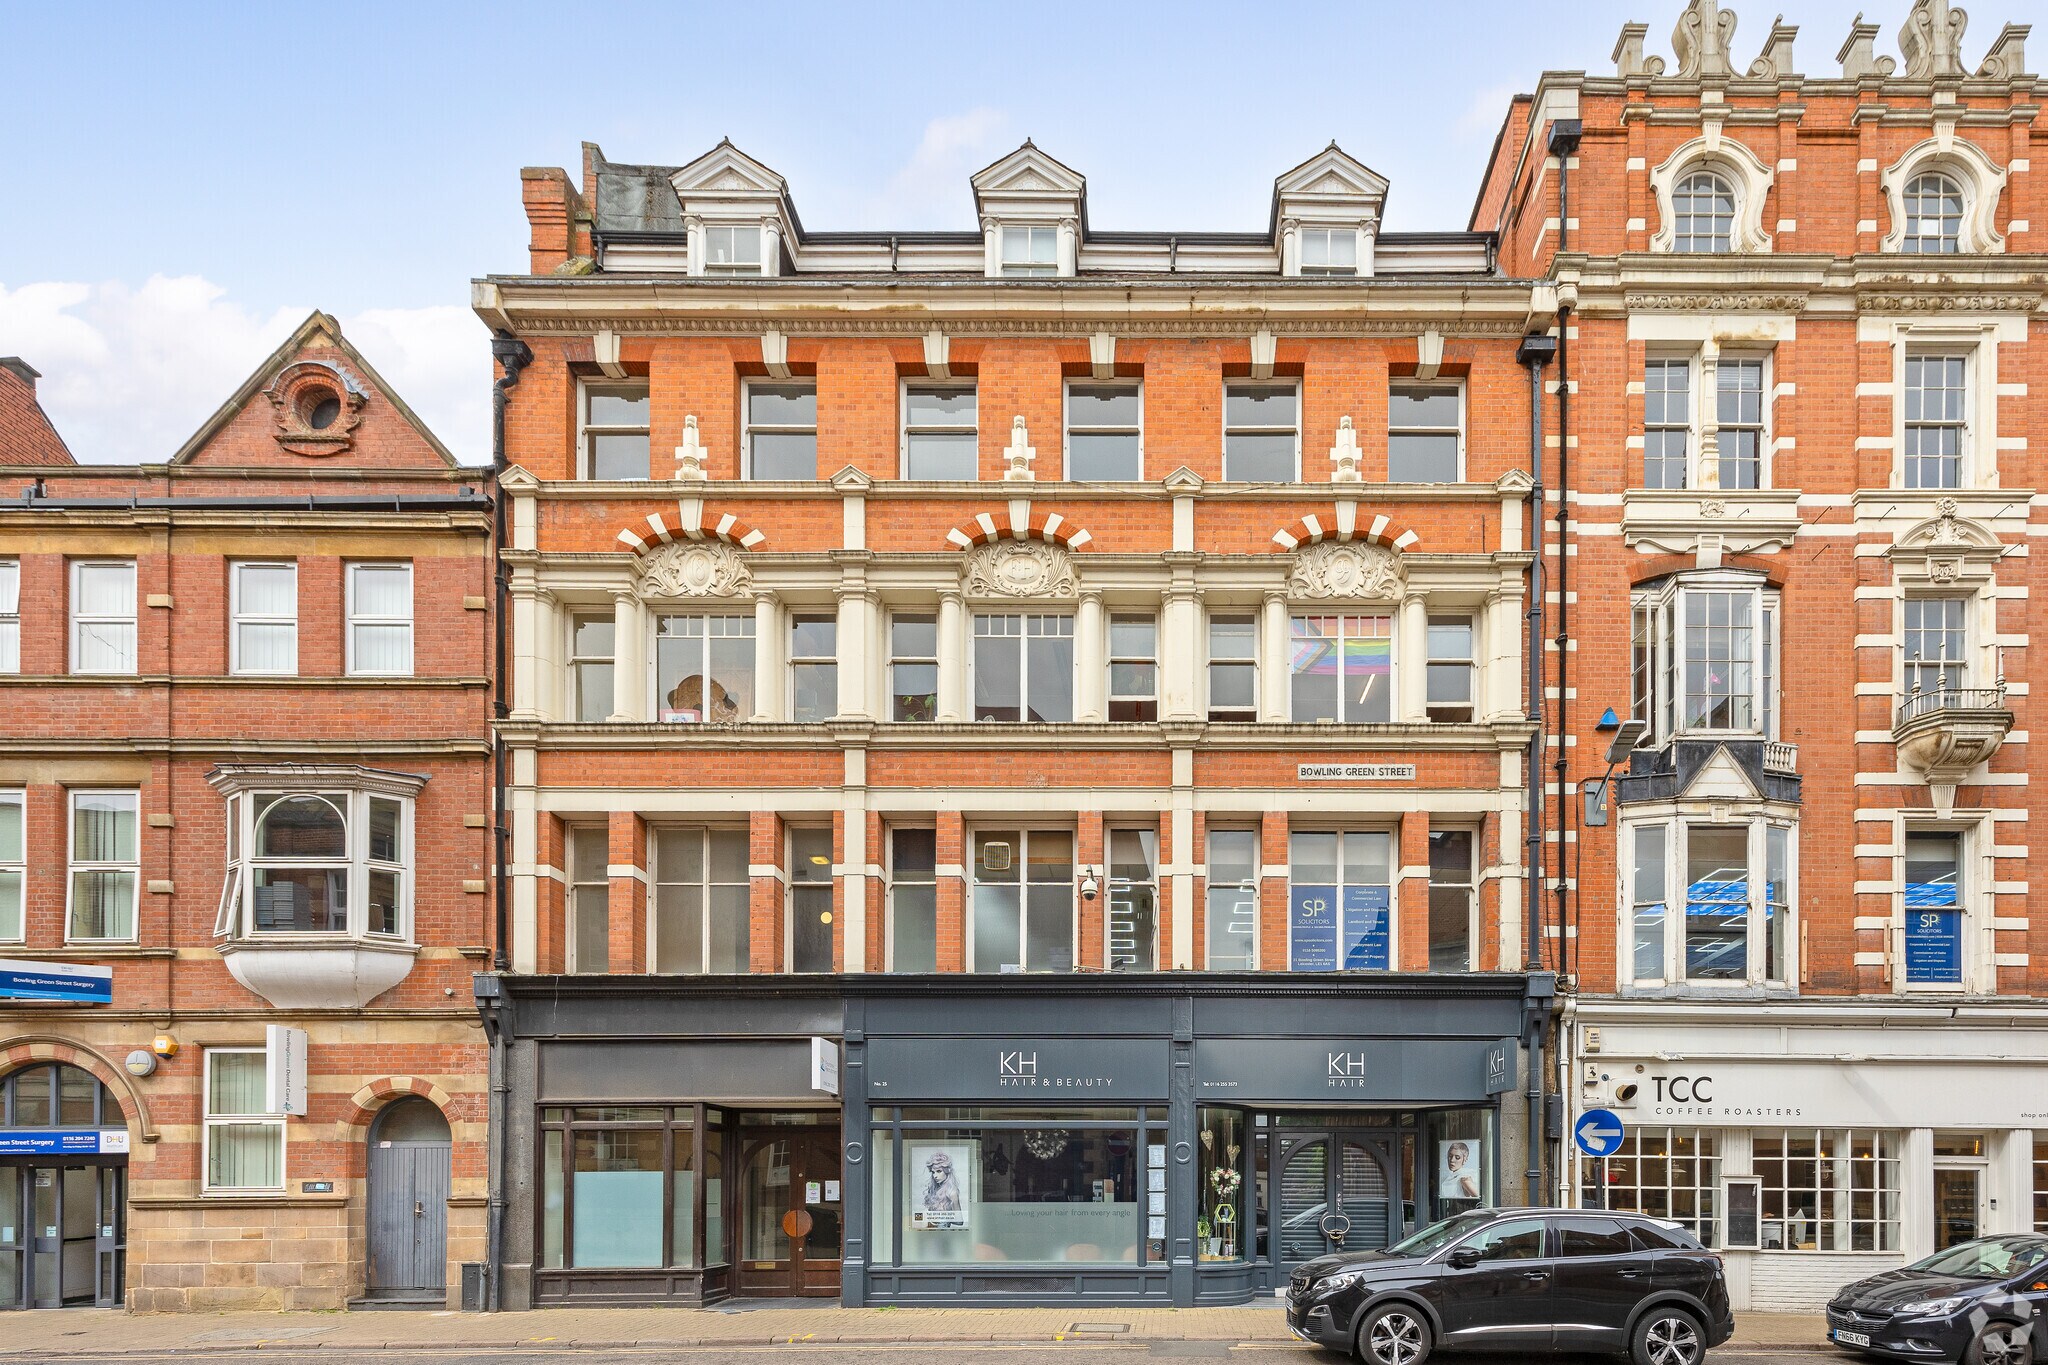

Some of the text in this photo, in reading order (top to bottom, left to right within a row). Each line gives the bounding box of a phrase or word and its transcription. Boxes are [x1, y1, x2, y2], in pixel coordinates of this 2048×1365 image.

[1301, 767, 1413, 776] BOWLING GREEN STREET
[1302, 899, 1326, 917] SP
[1920, 914, 1939, 927] SP
[13, 977, 36, 985] Bowling
[1000, 1051, 1036, 1074] KH
[1328, 1052, 1364, 1075] KH
[1490, 1047, 1504, 1074] KH
[1000, 1078, 1112, 1086] HAIR & BEAUTY
[1328, 1079, 1364, 1087] HAIR
[1652, 1076, 1712, 1102] TCC
[1655, 1107, 1801, 1116] COFFEE ROASTERS
[1112, 1209, 1131, 1217] angle
[1838, 1331, 1869, 1344] FN66 KYG
